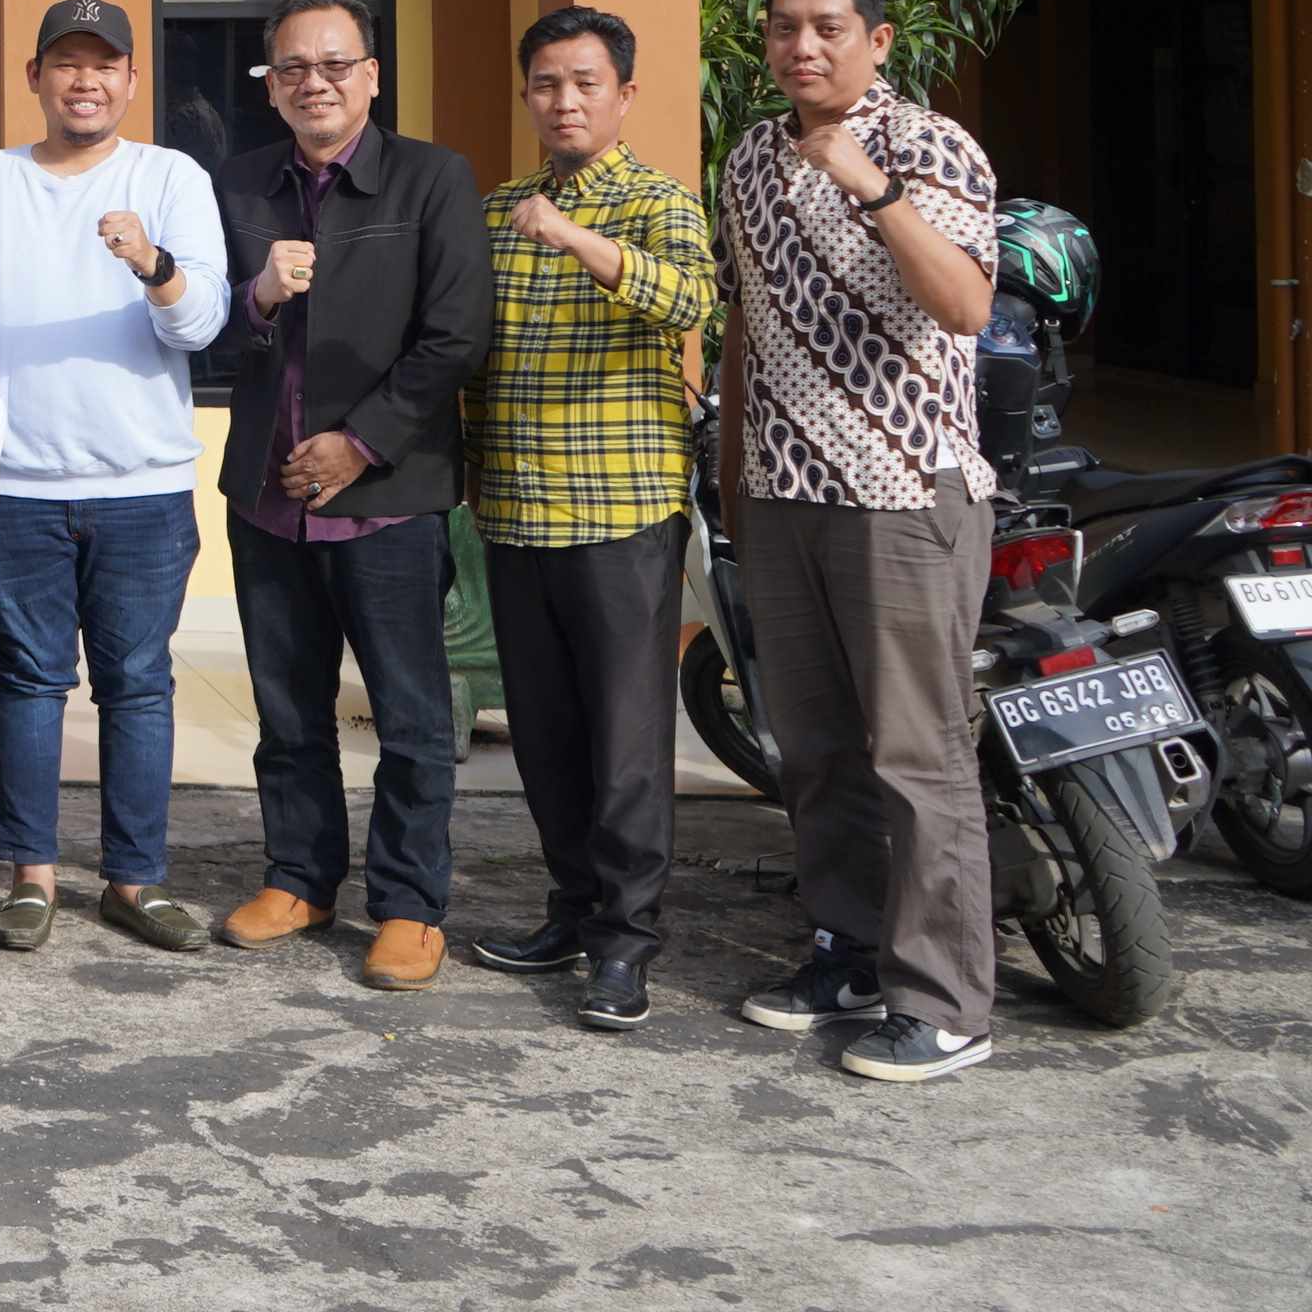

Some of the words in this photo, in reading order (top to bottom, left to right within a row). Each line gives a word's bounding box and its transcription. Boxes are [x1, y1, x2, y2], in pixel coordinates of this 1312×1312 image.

[1240, 582, 1272, 602] BG
[1000, 697, 1041, 728] BG
[1040, 678, 1114, 715] 6542
[1118, 664, 1170, 699] JBB
